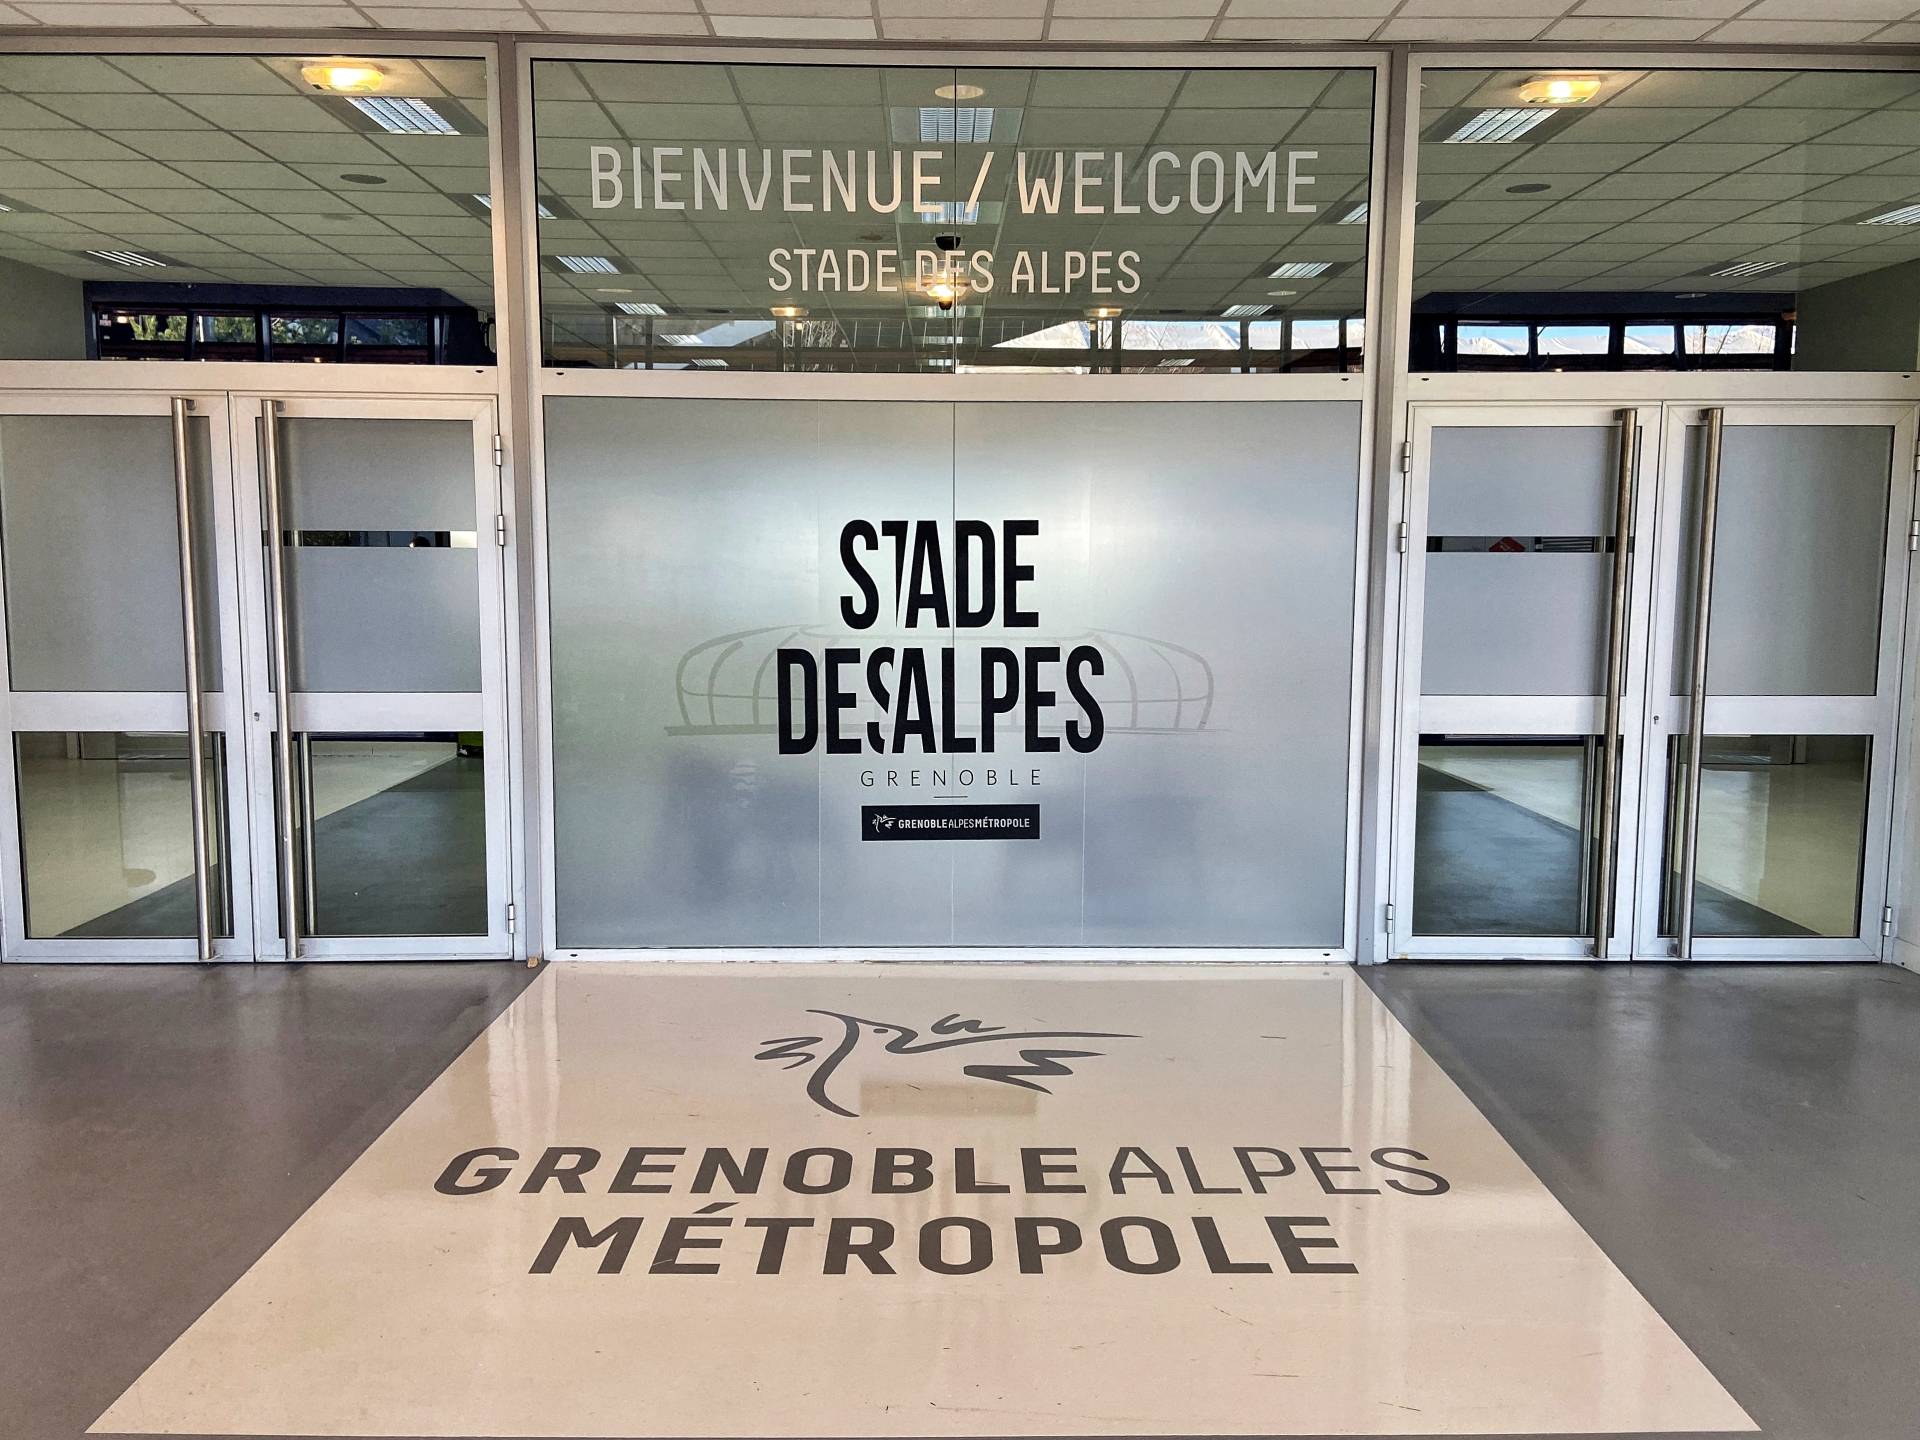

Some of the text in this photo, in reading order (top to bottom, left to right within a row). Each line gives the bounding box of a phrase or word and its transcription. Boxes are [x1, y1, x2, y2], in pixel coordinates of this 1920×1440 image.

[590, 145, 943, 214] BIENVENUE
[1017, 151, 1319, 215] WELCOME
[768, 248, 1141, 294] STADE DES ALPES
[839, 519, 1040, 630] STADE
[860, 768, 1042, 788] GRENOBLE
[528, 1200, 1359, 1275] MÉTROPOLE
